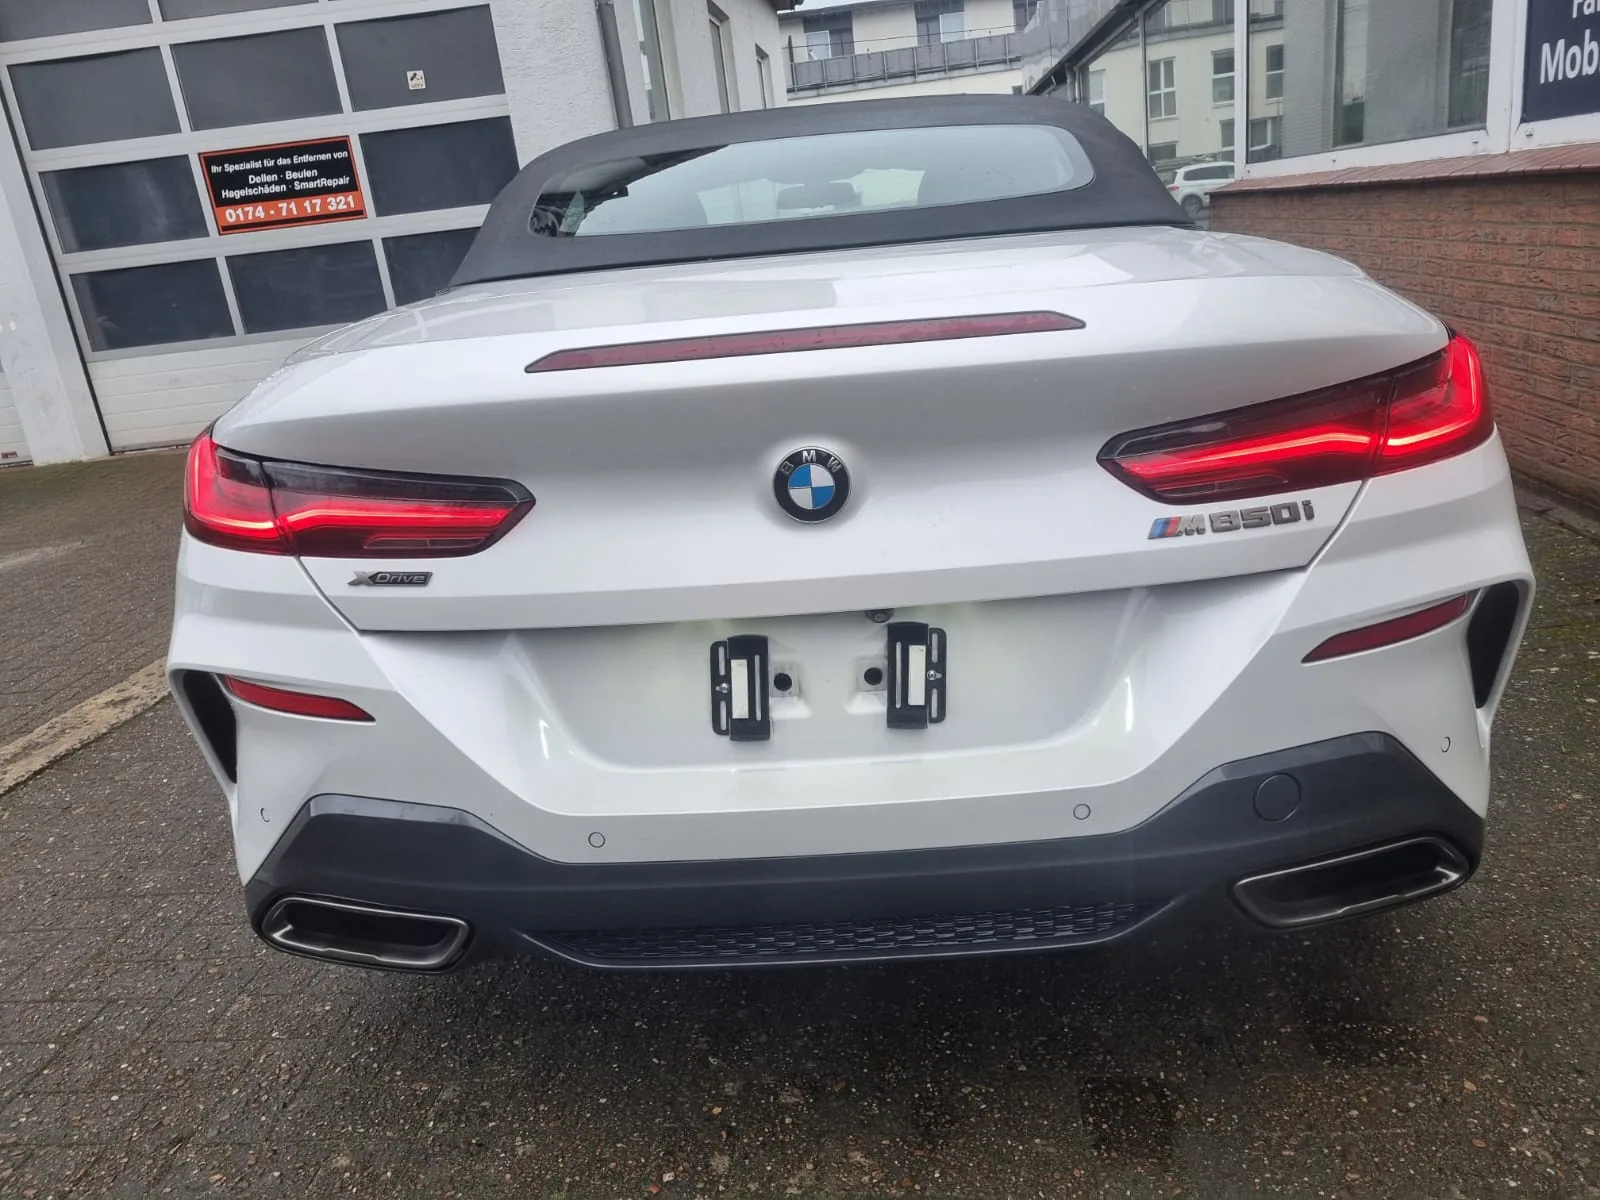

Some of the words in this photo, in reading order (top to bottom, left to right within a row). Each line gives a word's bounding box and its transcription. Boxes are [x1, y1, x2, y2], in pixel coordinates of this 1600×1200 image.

[1540, 29, 1600, 84] Mob
[211, 165, 222, 174] Ihr
[224, 160, 262, 173] Spezialist
[264, 158, 275, 167] für
[276, 157, 291, 165] das
[293, 153, 332, 164] Entfernen
[333, 151, 348, 159] von
[221, 184, 287, 199] Hagelschäden
[294, 175, 350, 190] SmartRepair
[248, 173, 278, 184] Dellen
[285, 169, 318, 180] Beulen
[225, 206, 265, 222] 0174
[278, 202, 298, 217] 71
[304, 199, 322, 213] 17
[327, 195, 355, 211] 321
[779, 449, 842, 477] BMW
